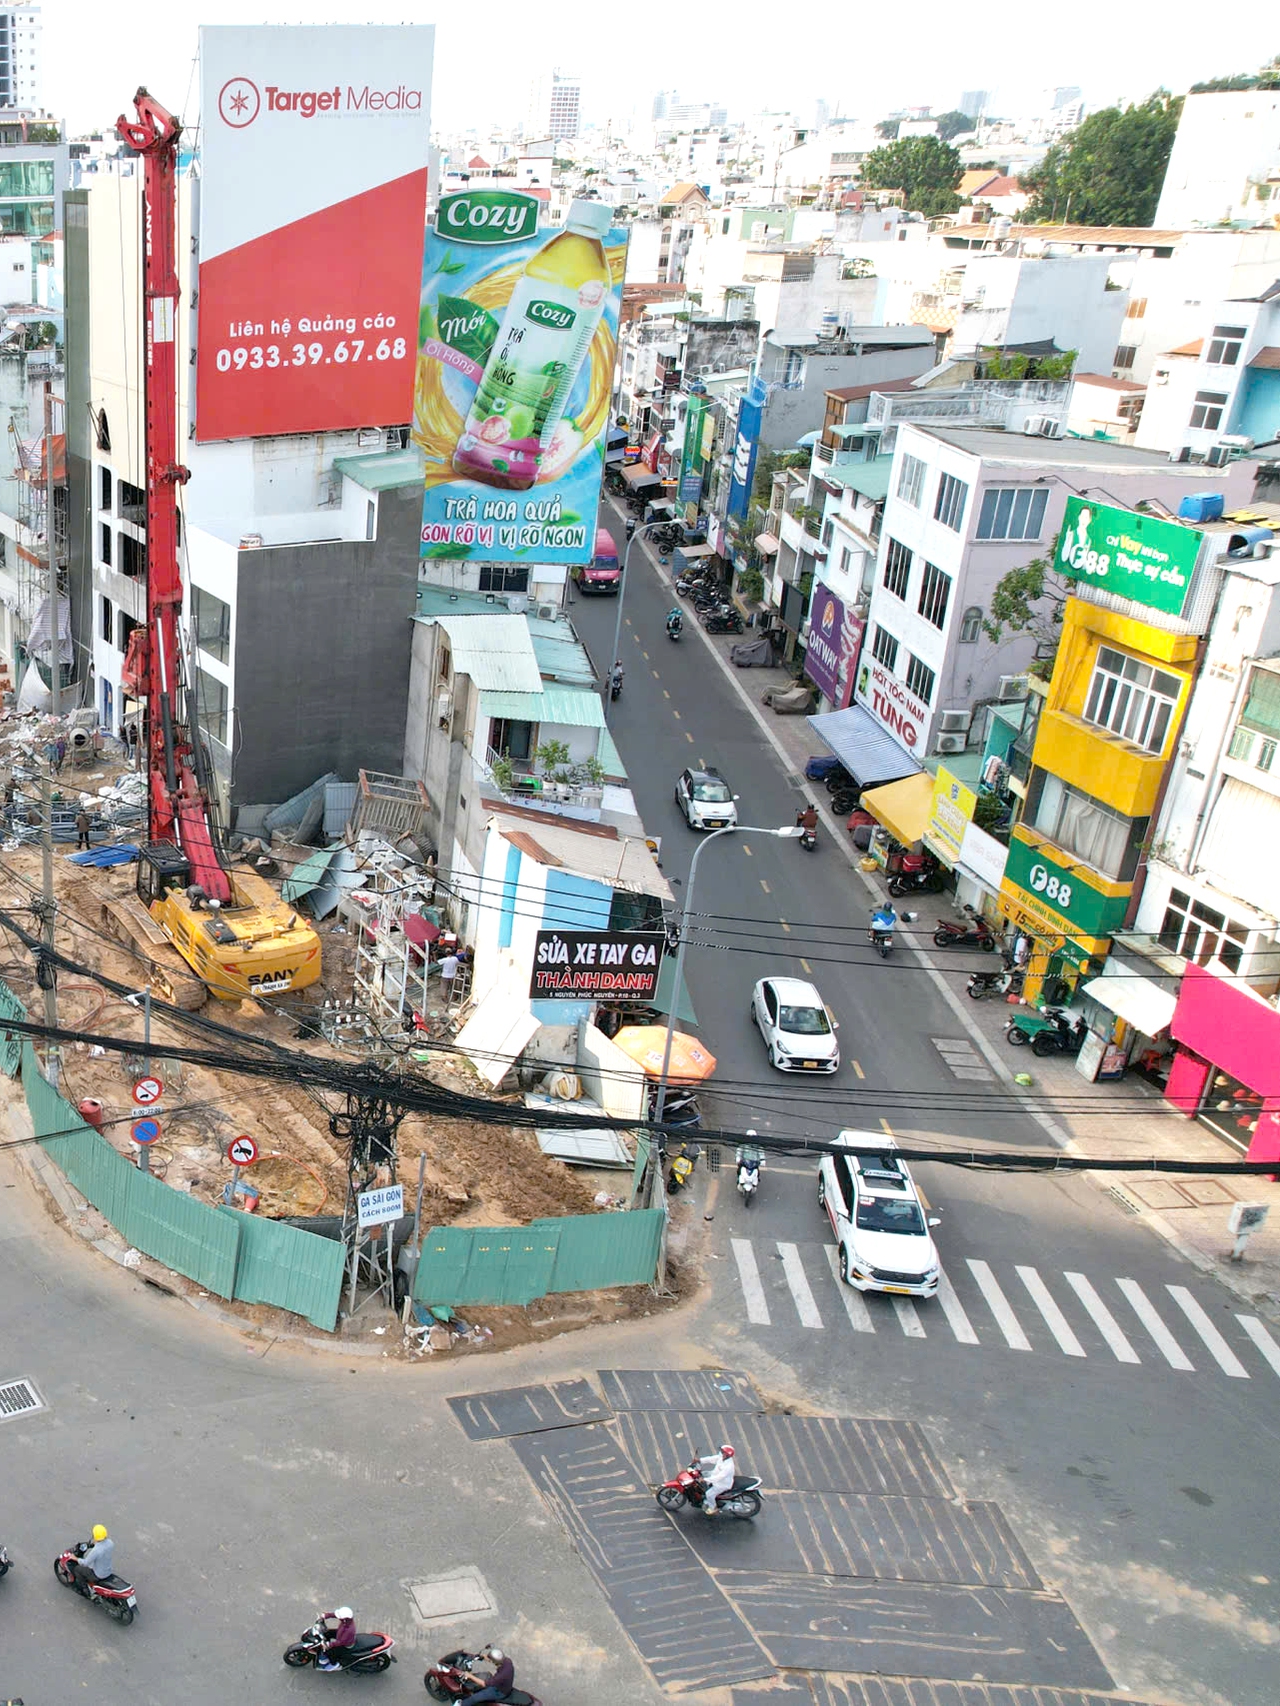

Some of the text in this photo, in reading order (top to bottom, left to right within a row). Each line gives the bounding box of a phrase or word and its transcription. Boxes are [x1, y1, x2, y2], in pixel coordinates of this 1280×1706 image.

[265, 86, 422, 118] Target Media
[447, 200, 528, 235] Cozy
[230, 313, 396, 338] Liên hệ Quảng cáo
[531, 303, 571, 326] Cozy
[216, 338, 406, 372] 0933.39.67.68
[445, 493, 562, 522] TRÀ HOA QUẢ
[455, 523, 475, 543] RÕ
[478, 527, 493, 547] VỊ
[500, 526, 516, 550] VỊ
[520, 524, 540, 545] RÕ
[545, 527, 585, 548] NGON
[809, 630, 838, 672] OATWAY
[872, 688, 919, 747] TÙNG
[906, 700, 925, 725] NAM
[1030, 865, 1071, 907] F88
[537, 935, 657, 966] SỬA XE TAY GA
[248, 967, 299, 986] SANY
[536, 965, 654, 989] THÀNH DANH
[360, 1197, 370, 1208] GA
